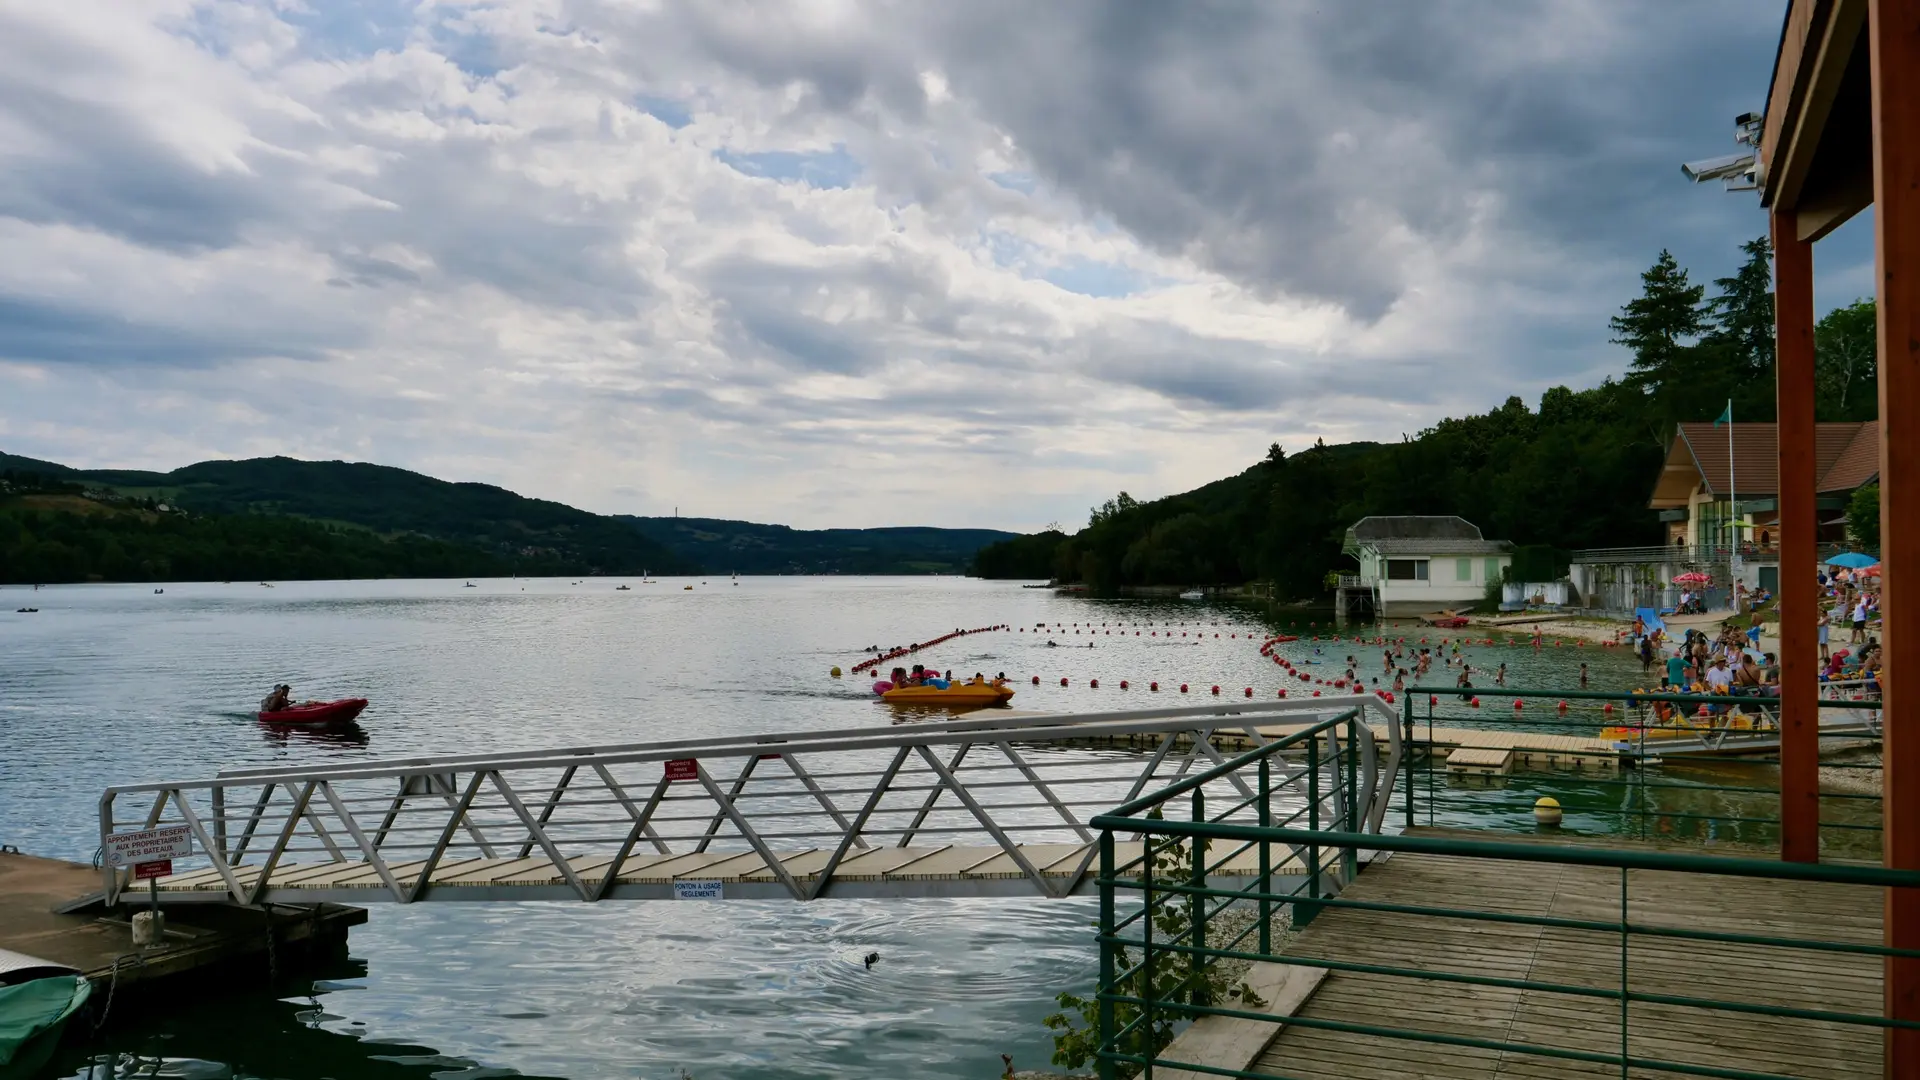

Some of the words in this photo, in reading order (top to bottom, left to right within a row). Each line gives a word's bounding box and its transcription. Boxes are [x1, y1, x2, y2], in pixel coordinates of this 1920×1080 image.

[108, 832, 157, 844] APPONTEMENT
[132, 836, 184, 848] PROPRIETAIRES
[127, 849, 141, 857] DES
[144, 845, 174, 854] BATEAUX
